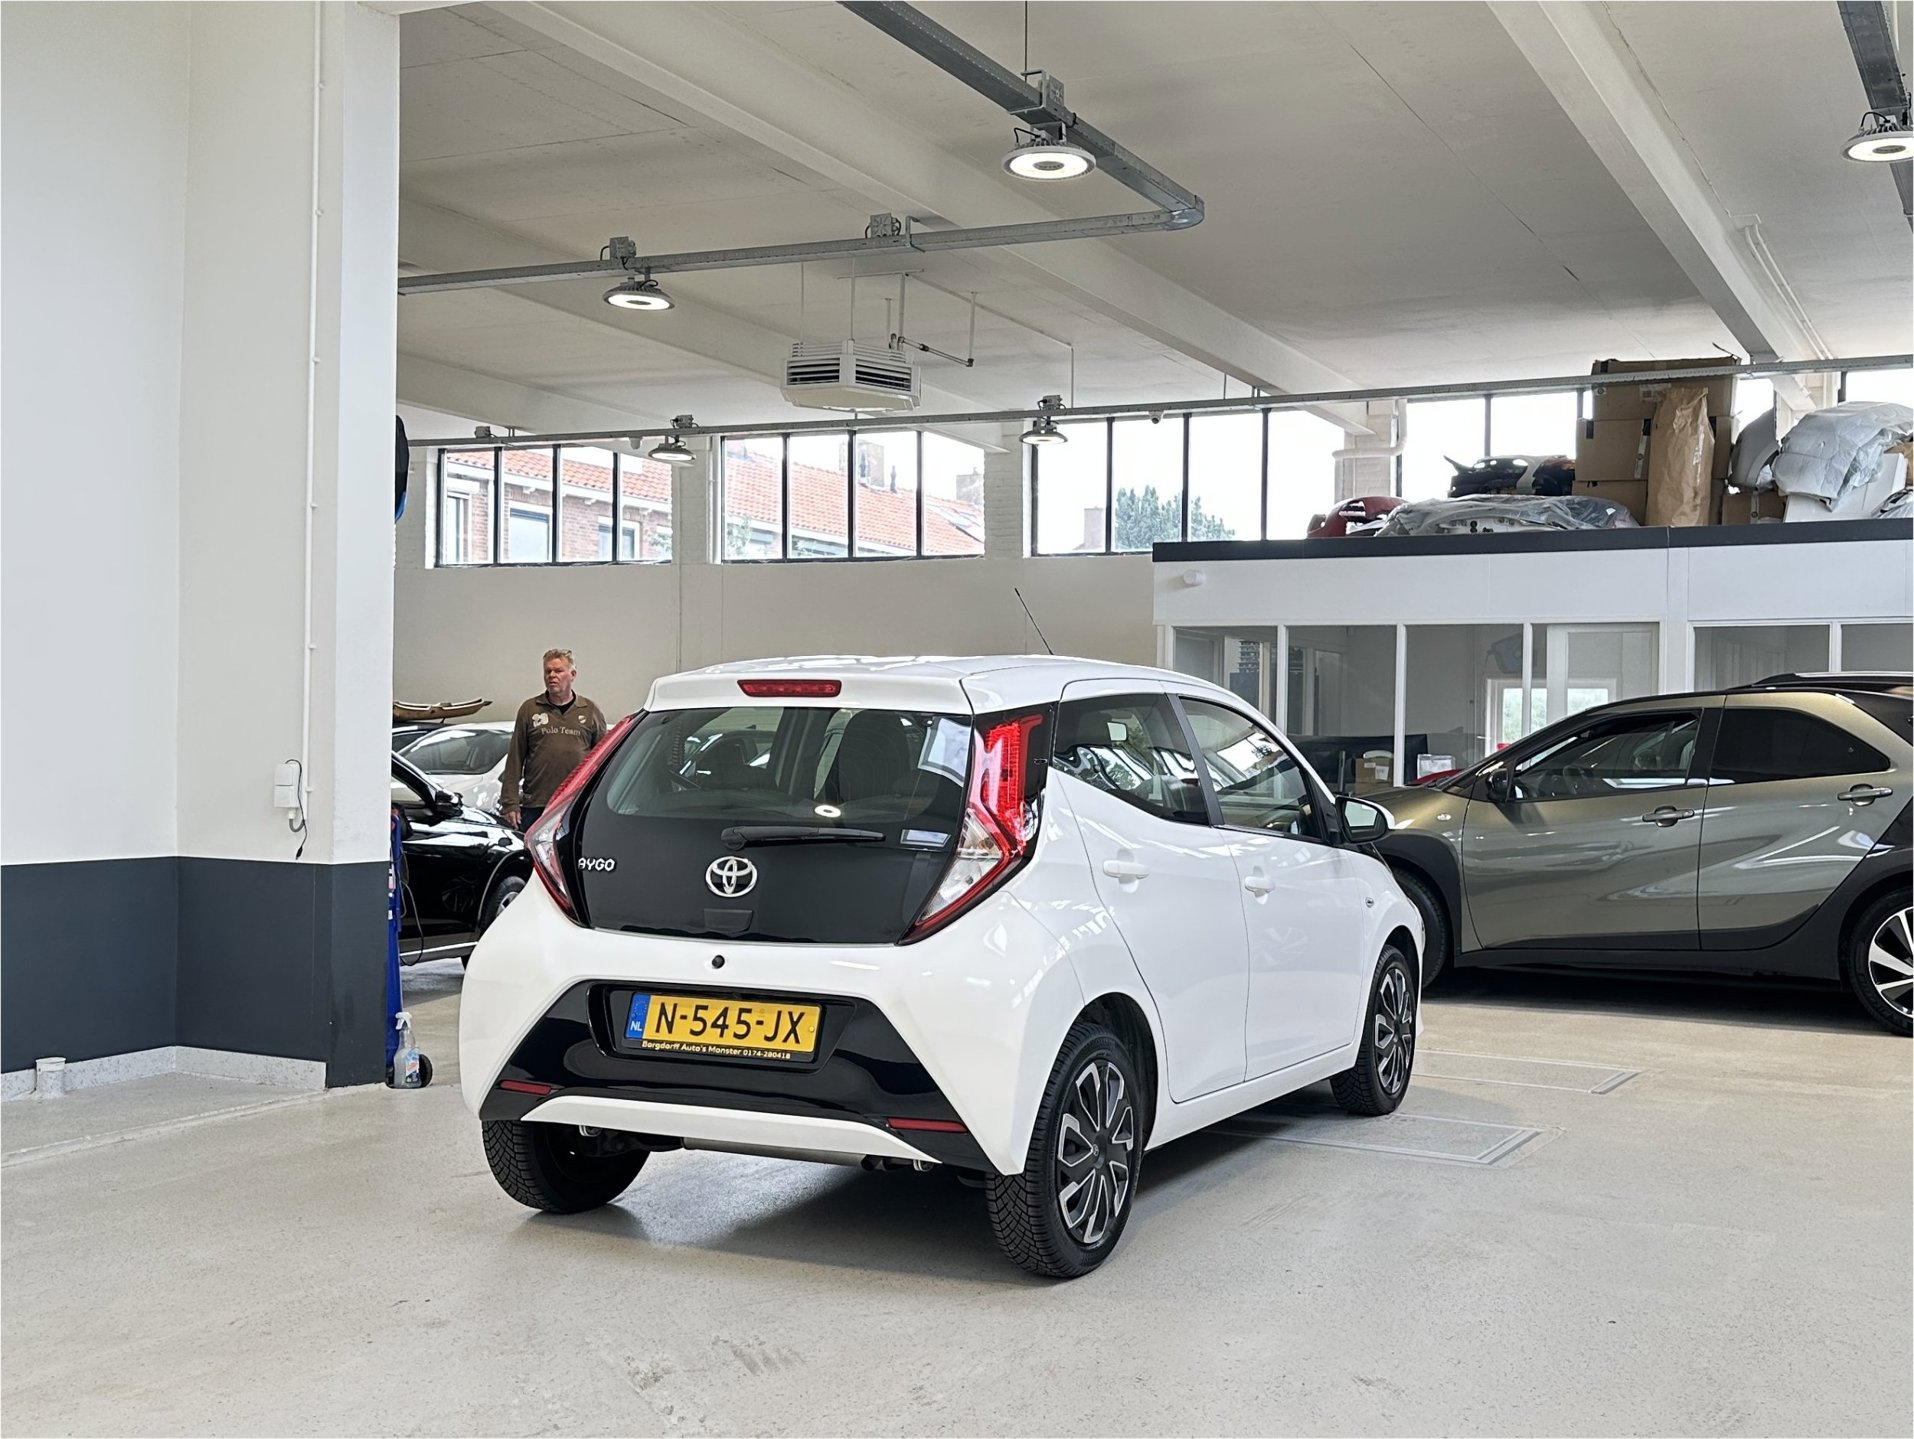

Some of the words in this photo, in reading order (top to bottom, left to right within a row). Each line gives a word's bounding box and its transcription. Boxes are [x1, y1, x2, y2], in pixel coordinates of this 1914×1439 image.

[541, 725, 559, 735] Polo
[578, 857, 615, 872] AYGO
[630, 1020, 643, 1032] NL
[655, 1002, 805, 1044] N-545-JX
[680, 1043, 707, 1053] Auto's
[708, 1046, 742, 1056] Monster
